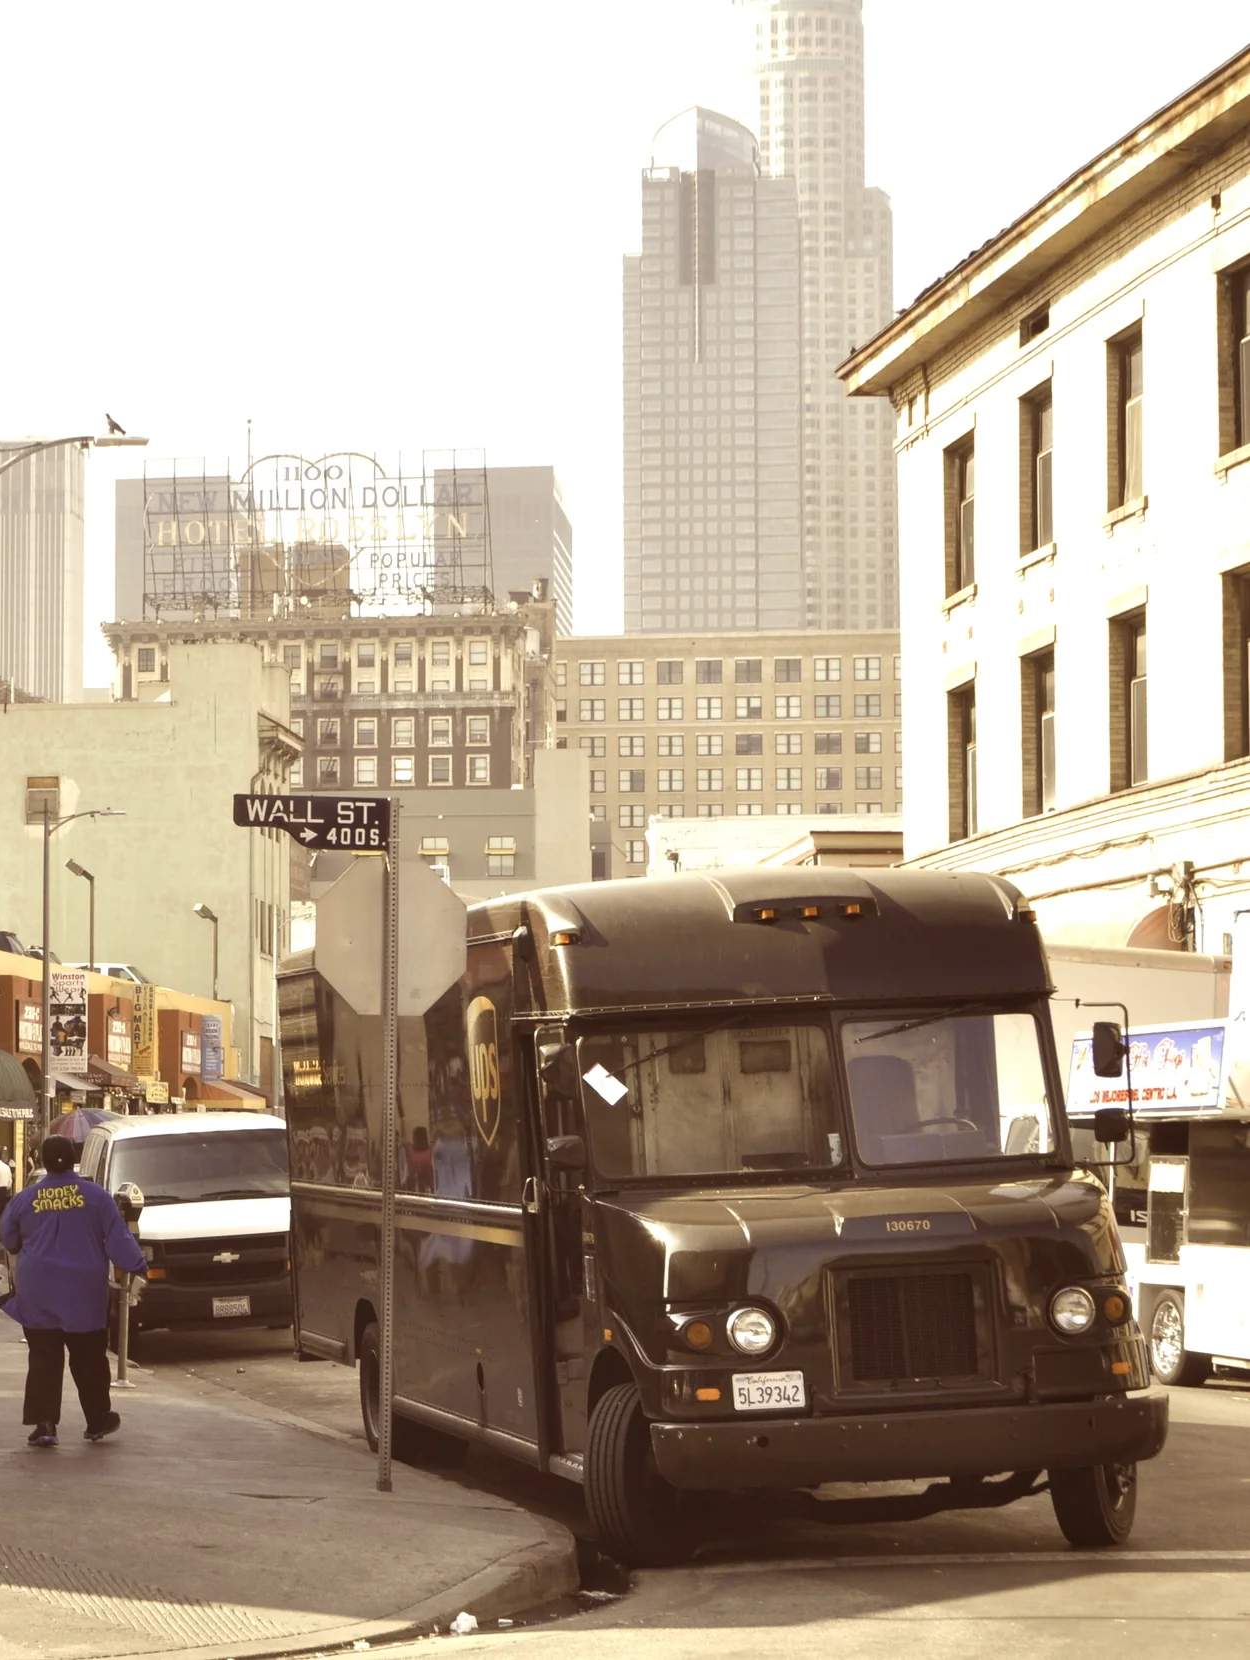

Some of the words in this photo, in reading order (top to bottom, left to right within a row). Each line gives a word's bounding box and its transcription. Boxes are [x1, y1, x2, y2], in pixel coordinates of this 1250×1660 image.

[233, 487, 347, 511] MILLION
[362, 484, 472, 508] DOLLAR
[157, 520, 278, 546] HOTEL
[297, 513, 468, 542] ROSSLYN
[370, 551, 459, 568] POPULAR
[379, 572, 450, 588] PRICES
[246, 799, 324, 823] WALL
[337, 801, 379, 825] ST.
[51, 972, 85, 981] Winston
[134, 986, 142, 1012] BIG
[133, 1015, 142, 1050] MART
[470, 1043, 498, 1122] ups
[37, 1184, 79, 1200] HONEY
[32, 1195, 85, 1213] SMACKS
[886, 1220, 930, 1231] 130670
[746, 1374, 786, 1386] California
[738, 1385, 801, 1406] 5L39342
